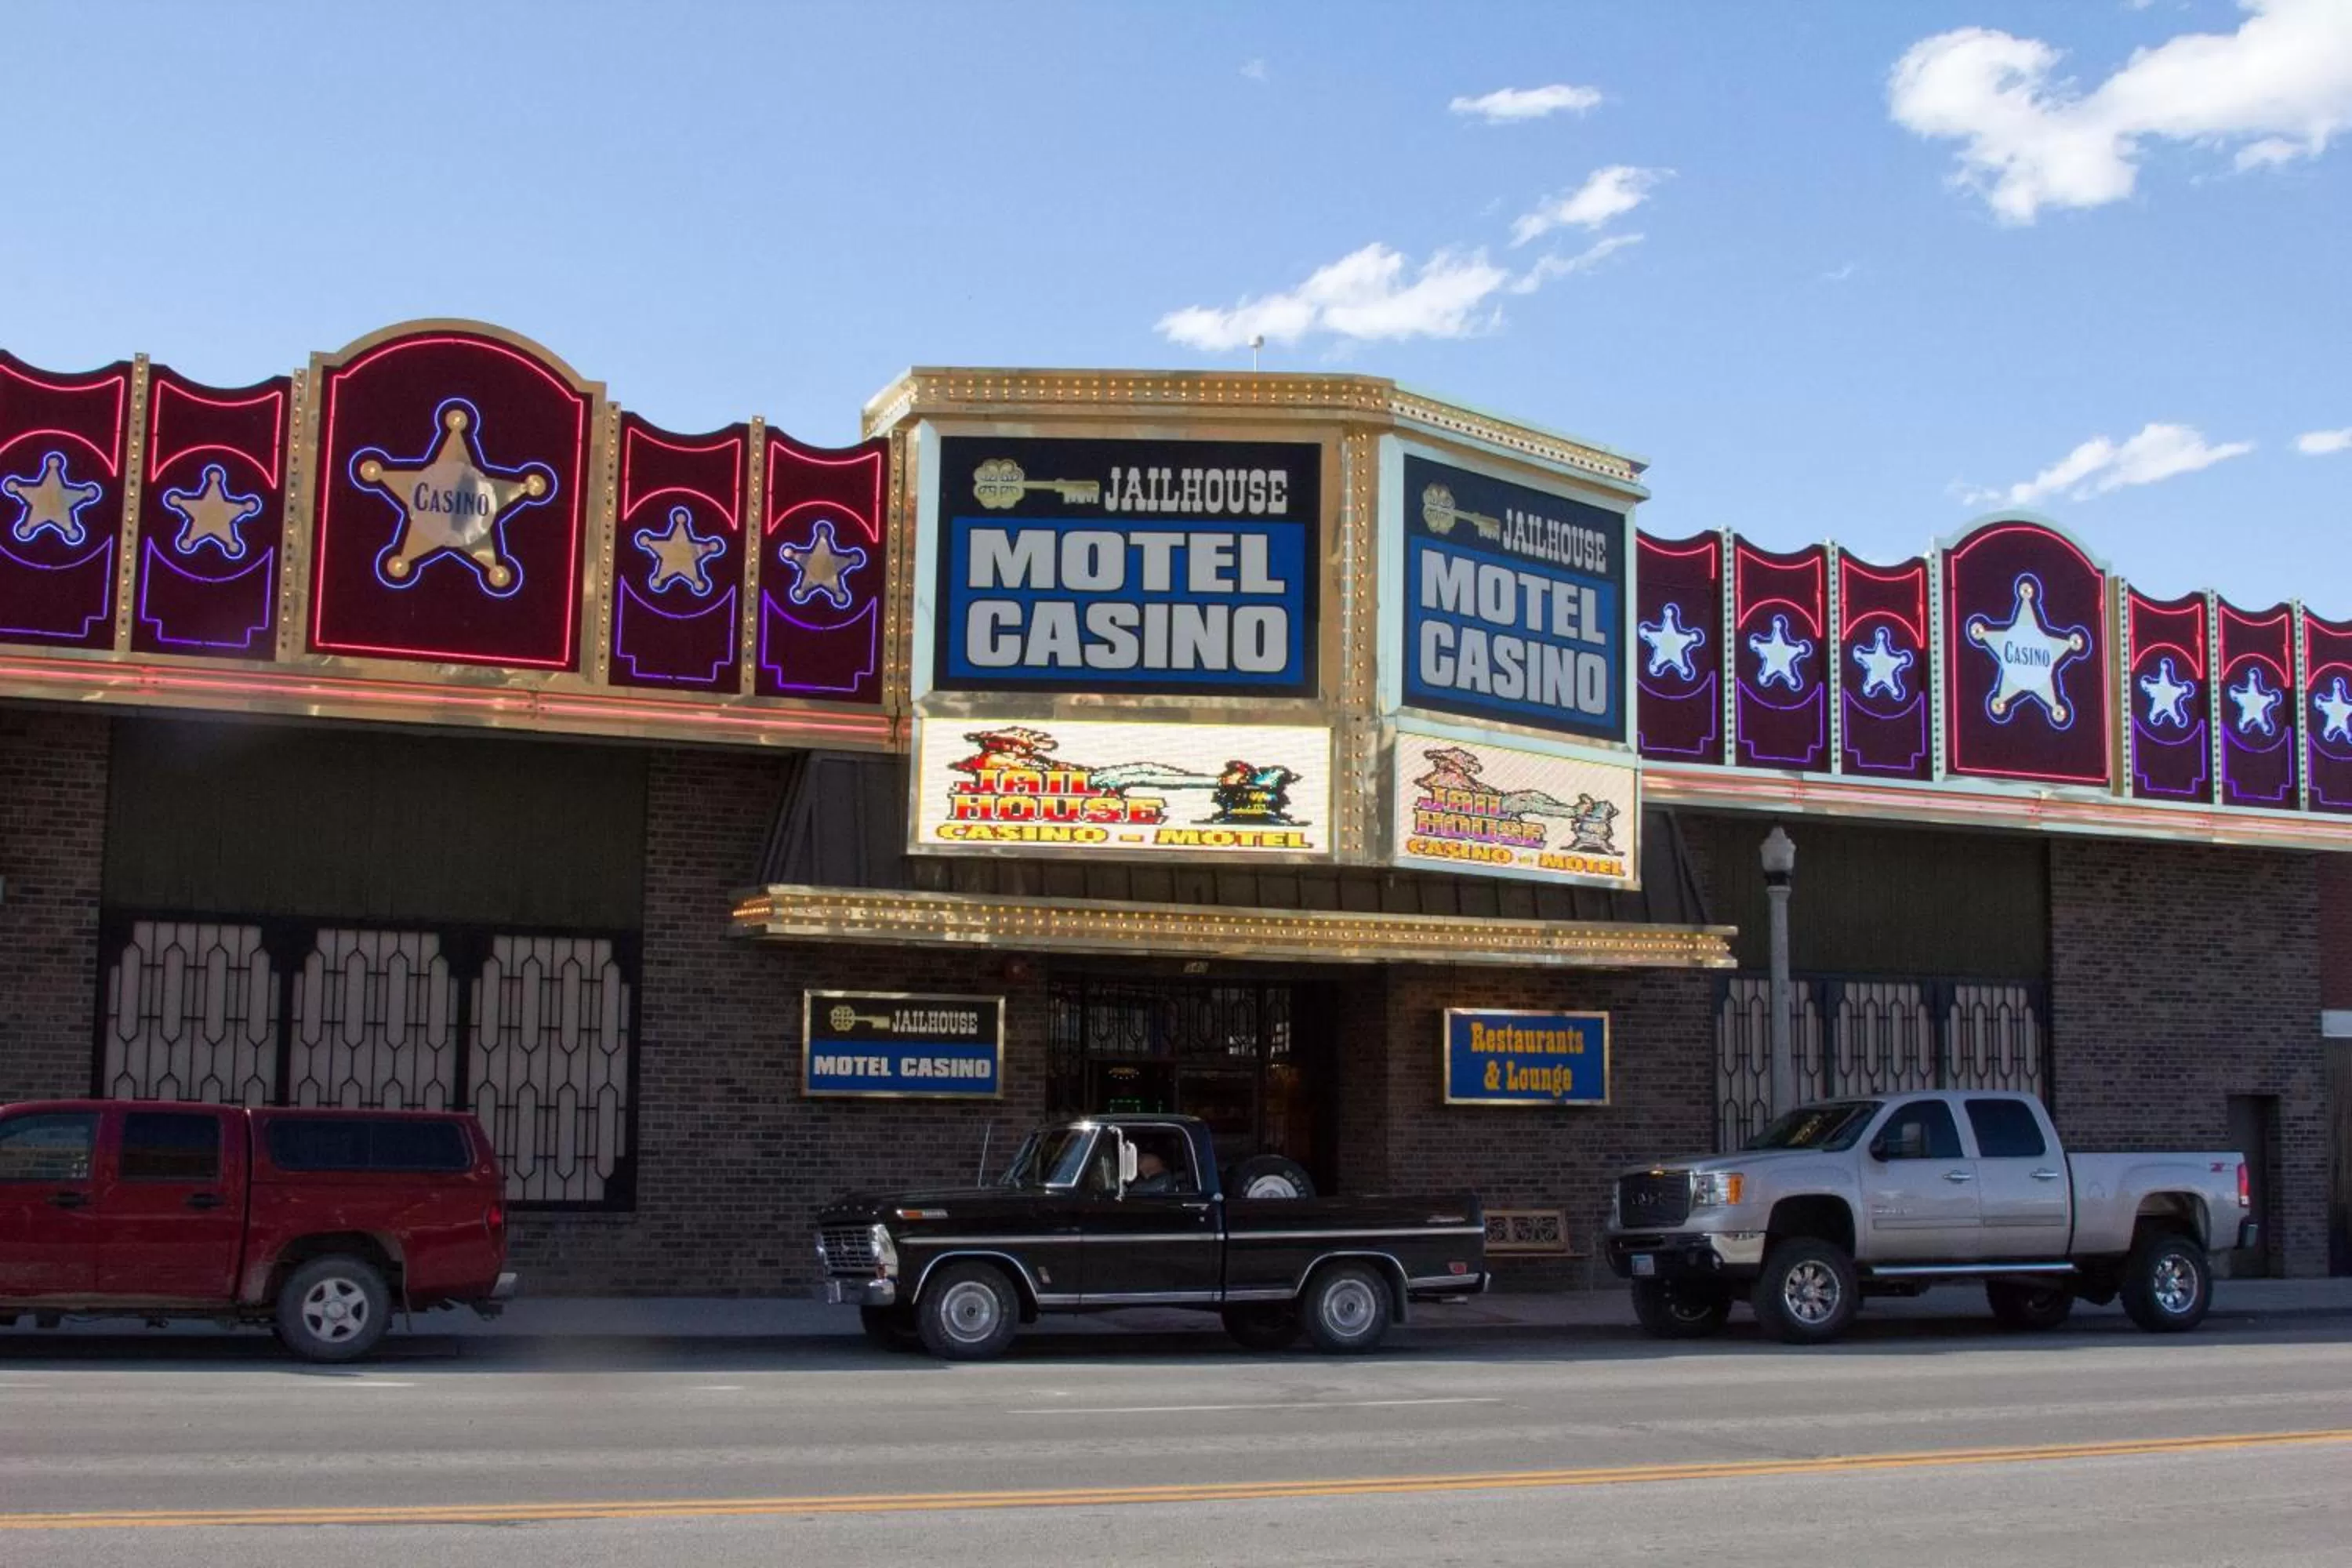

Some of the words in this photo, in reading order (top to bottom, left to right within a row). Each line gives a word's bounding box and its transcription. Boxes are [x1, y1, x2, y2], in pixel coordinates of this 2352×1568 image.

[414, 482, 488, 516] CASINO
[1105, 467, 1287, 514] JAILHOUSE
[1503, 508, 1606, 574] JAILHOUSE
[967, 528, 1286, 593] MOTEL
[1421, 549, 1606, 645] MOTEL
[967, 600, 1287, 672] CASINO
[2005, 641, 2050, 666] CASINO
[1420, 619, 1607, 715] CASINO
[952, 768, 1103, 794] JAIL
[947, 793, 1170, 823] HOUSE
[1417, 786, 1510, 819] JAIL
[935, 823, 1109, 844] CASINO
[1152, 827, 1314, 848] MOTEL
[1413, 808, 1548, 849] HOUSE
[1406, 837, 1513, 865] CASINO
[1538, 852, 1625, 877] MOTEL
[892, 1010, 978, 1035] JAILHOUSE
[1471, 1022, 1584, 1054] Restaurants
[814, 1056, 892, 1076] MOTEL
[901, 1058, 991, 1078] CASINO
[1484, 1060, 1501, 1091] &
[1506, 1060, 1573, 1097] Lounge
